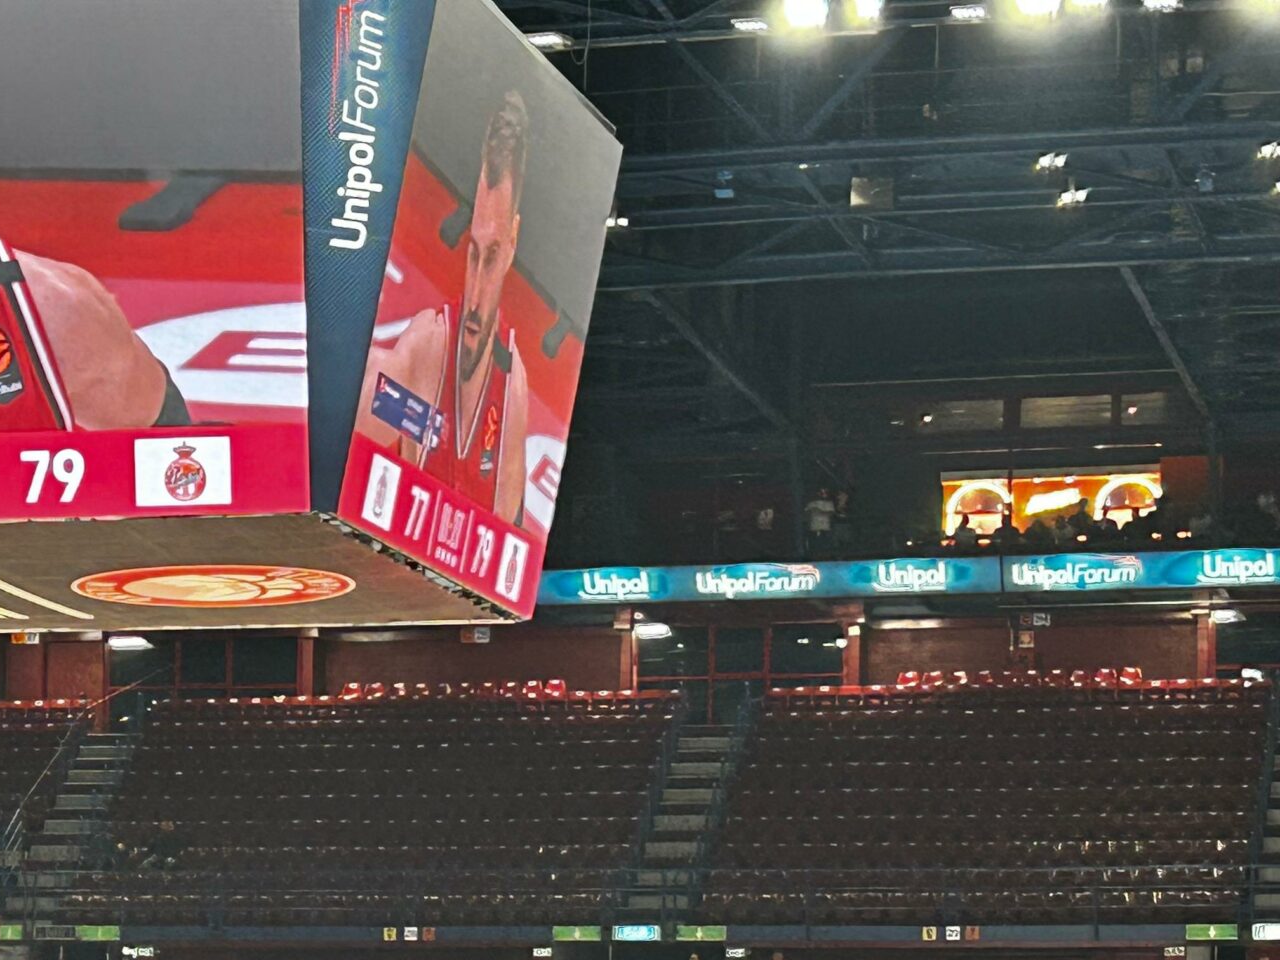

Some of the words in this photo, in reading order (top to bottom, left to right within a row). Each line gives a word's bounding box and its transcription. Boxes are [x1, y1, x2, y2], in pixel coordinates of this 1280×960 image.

[328, 10, 388, 250] UnipolForum
[20, 448, 85, 504] 79
[404, 485, 431, 541] 77
[470, 524, 495, 578] 79
[1202, 550, 1274, 583] Unipol
[582, 570, 650, 599] Unipol
[696, 571, 814, 599] UnipolForum
[877, 561, 947, 591] Unipol
[1012, 564, 1138, 591] UnipolForum
